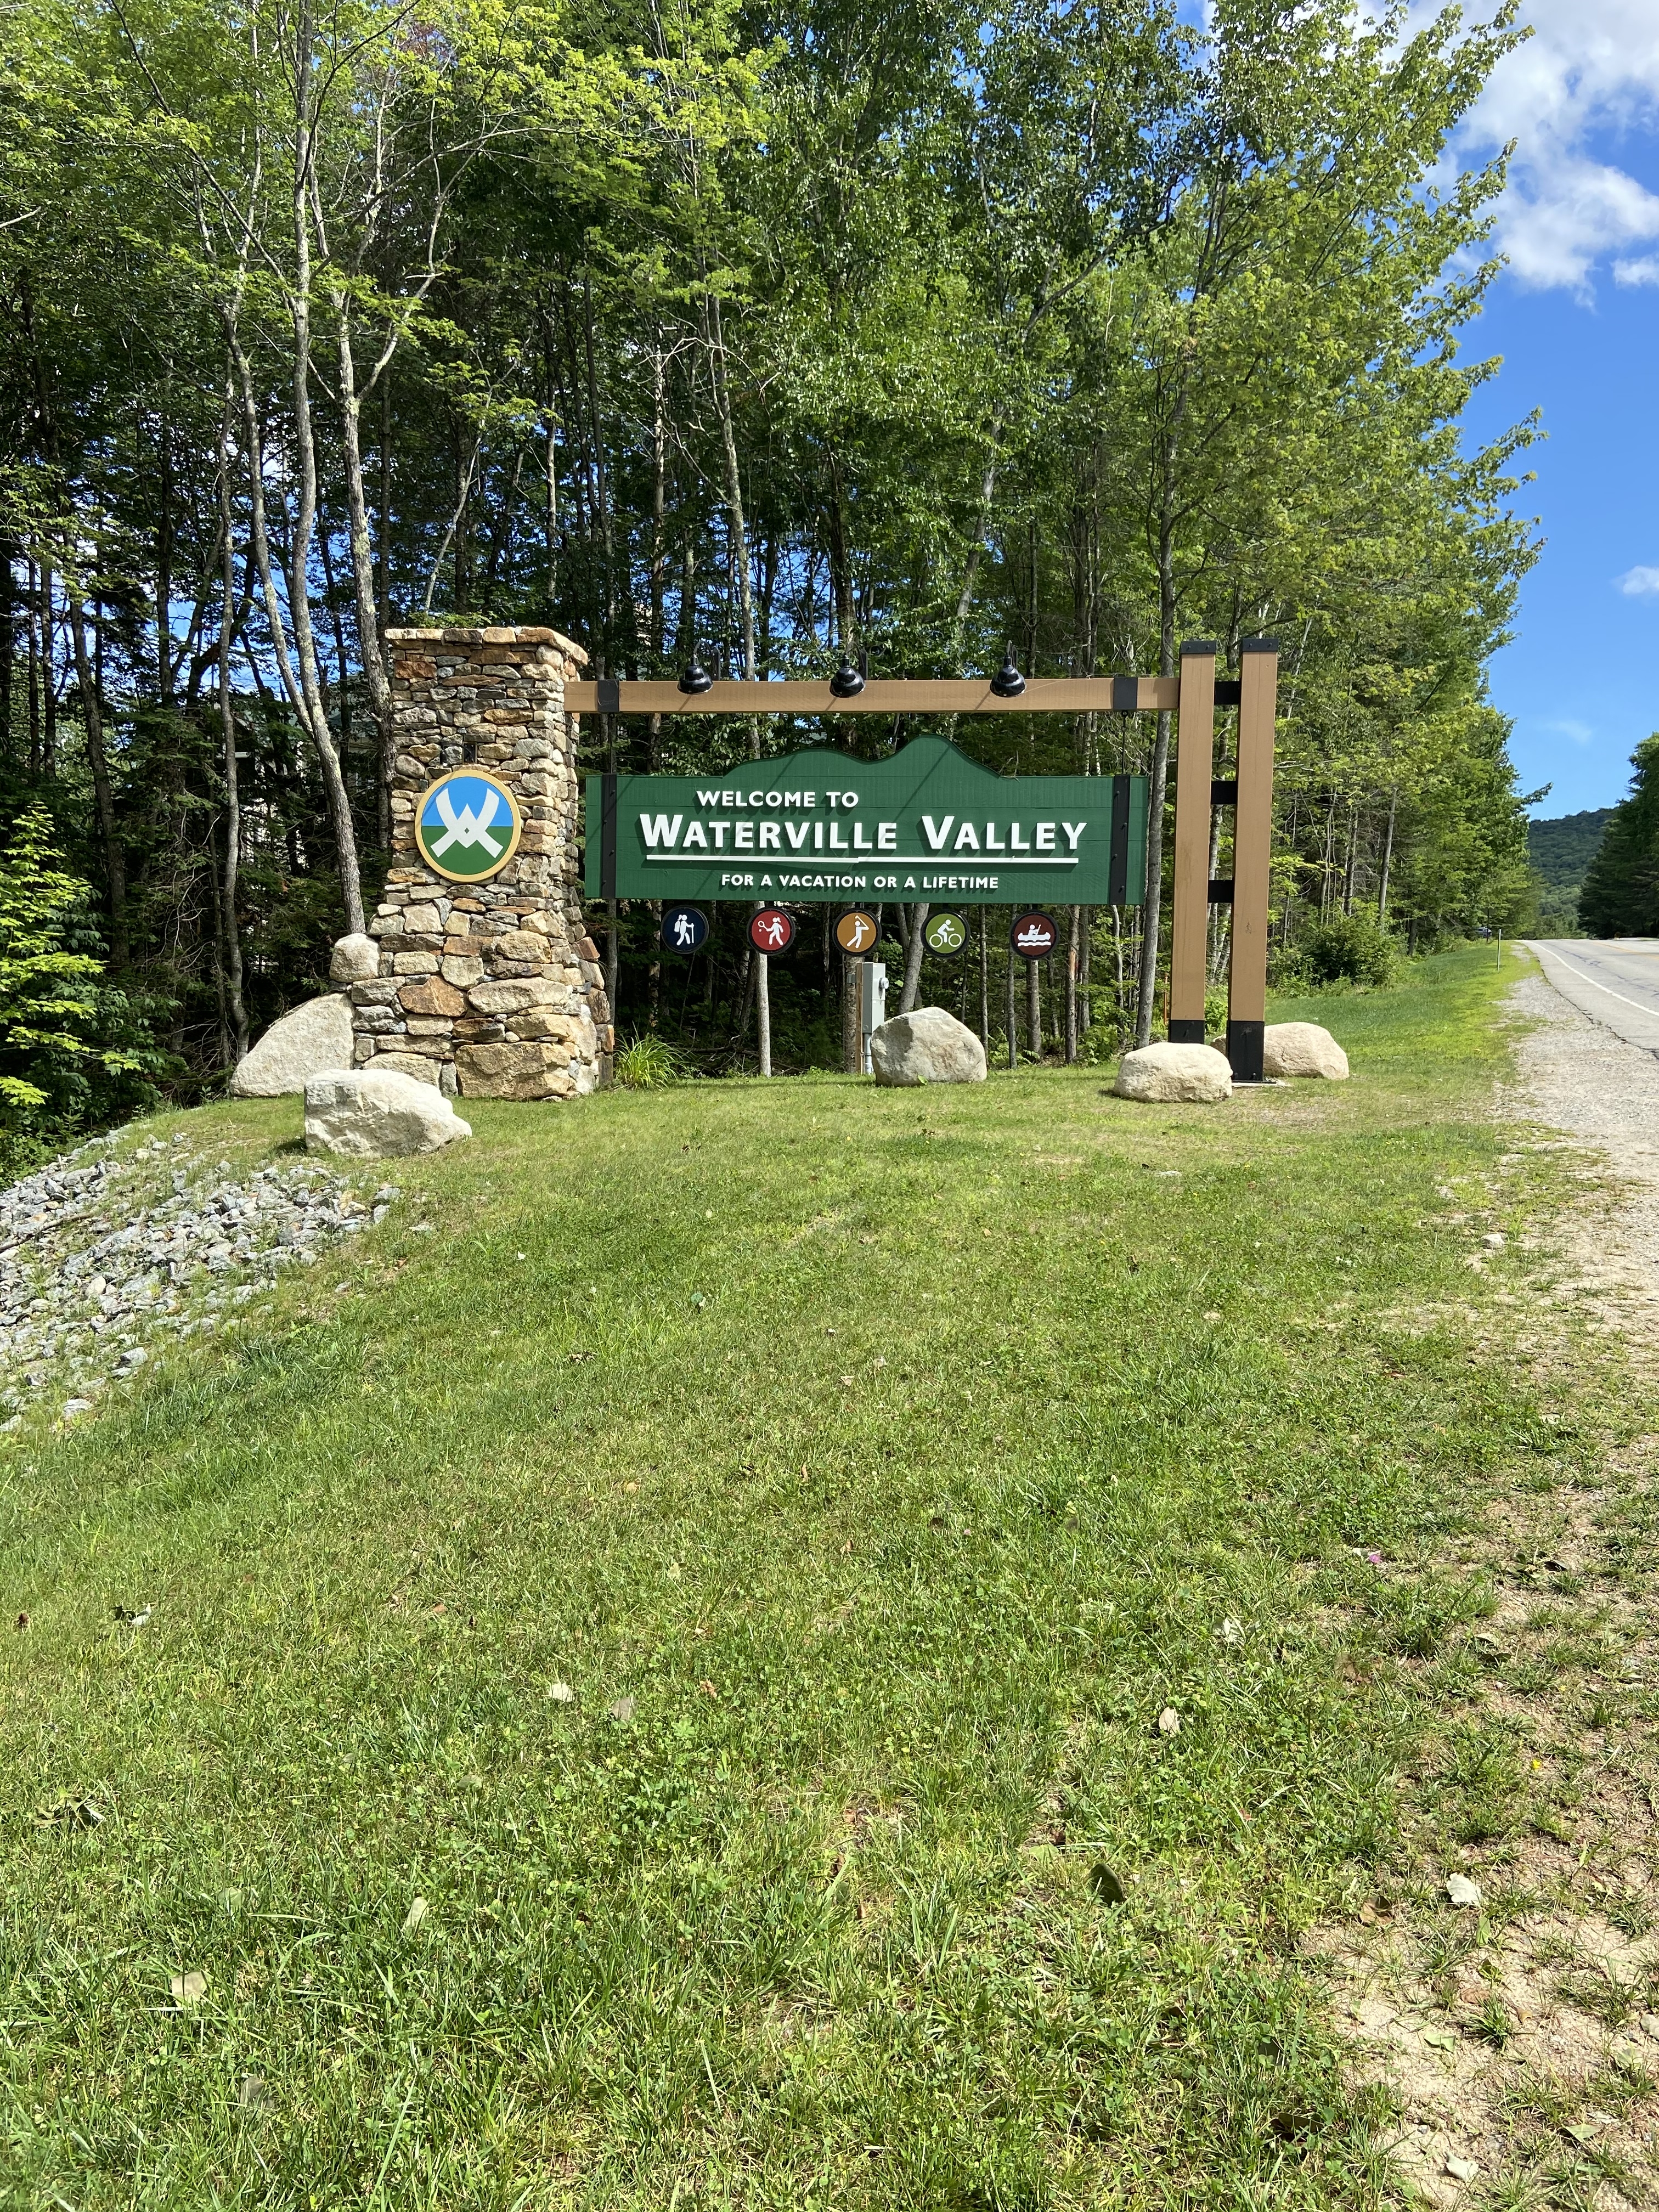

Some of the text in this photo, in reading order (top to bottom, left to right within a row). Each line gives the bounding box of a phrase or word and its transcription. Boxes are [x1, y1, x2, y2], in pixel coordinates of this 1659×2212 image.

[696, 791, 859, 808] WELCOME TO
[639, 814, 1087, 850] WATERVILLE VALLEY
[721, 874, 998, 889] FOR A VACATION OR A LIFETIME
